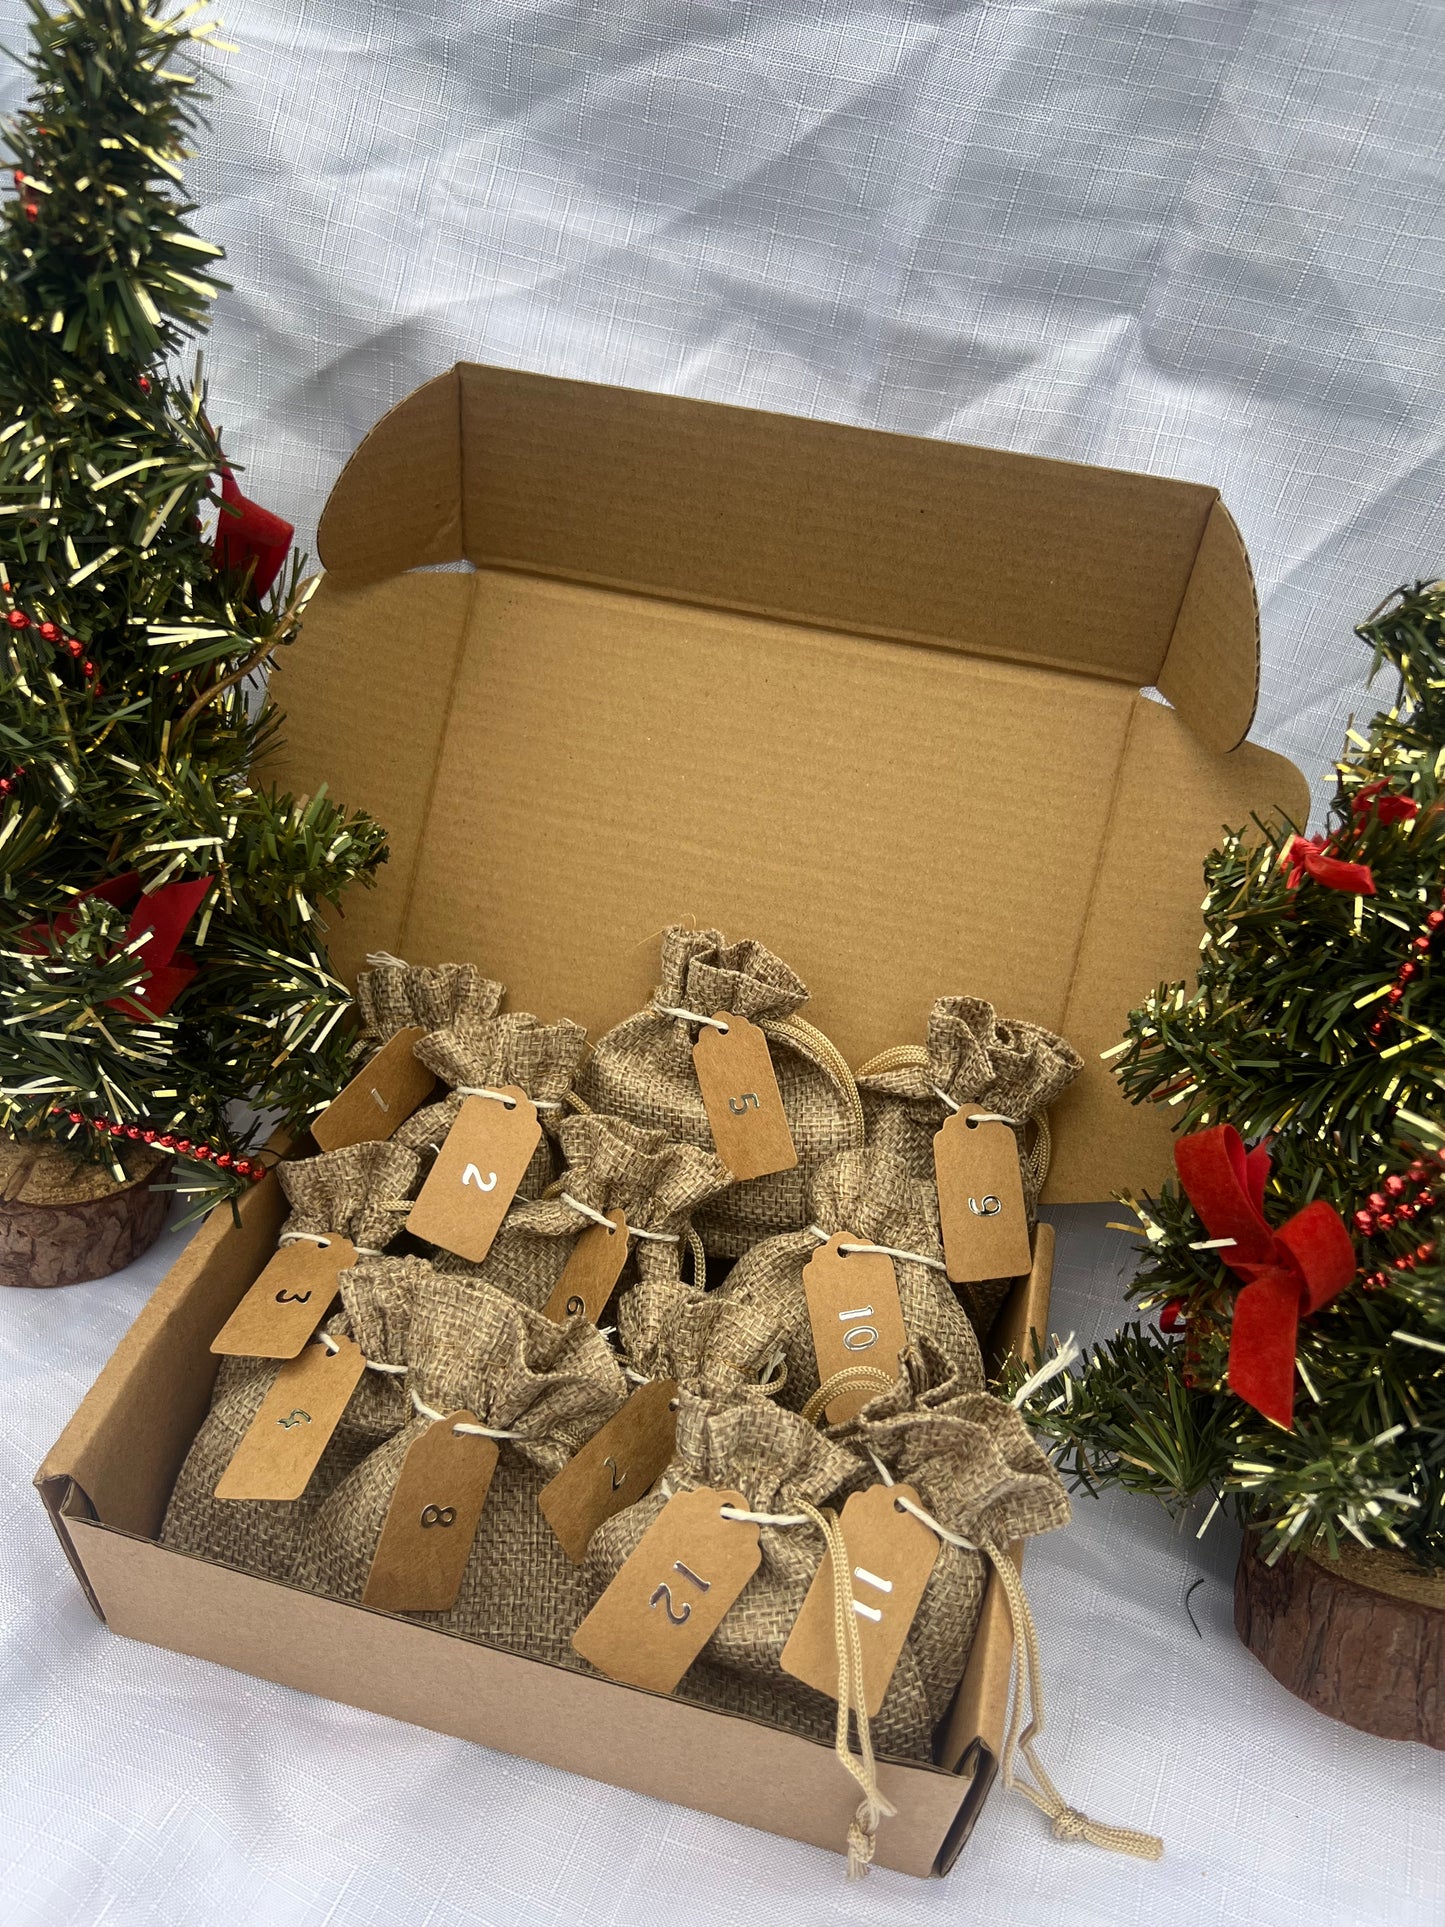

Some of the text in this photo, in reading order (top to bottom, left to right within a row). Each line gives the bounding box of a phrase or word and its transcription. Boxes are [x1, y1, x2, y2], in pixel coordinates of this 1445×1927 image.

[370, 1087, 390, 1113] 1
[729, 1092, 761, 1115] 5
[462, 1163, 498, 1192] 2
[968, 1194, 1002, 1216] 9
[275, 1288, 313, 1305] 3
[838, 1305, 879, 1351] 10
[276, 1408, 312, 1429] 4
[420, 1503, 458, 1529] 8
[649, 1560, 711, 1625] 12
[851, 1566, 893, 1622] 11
